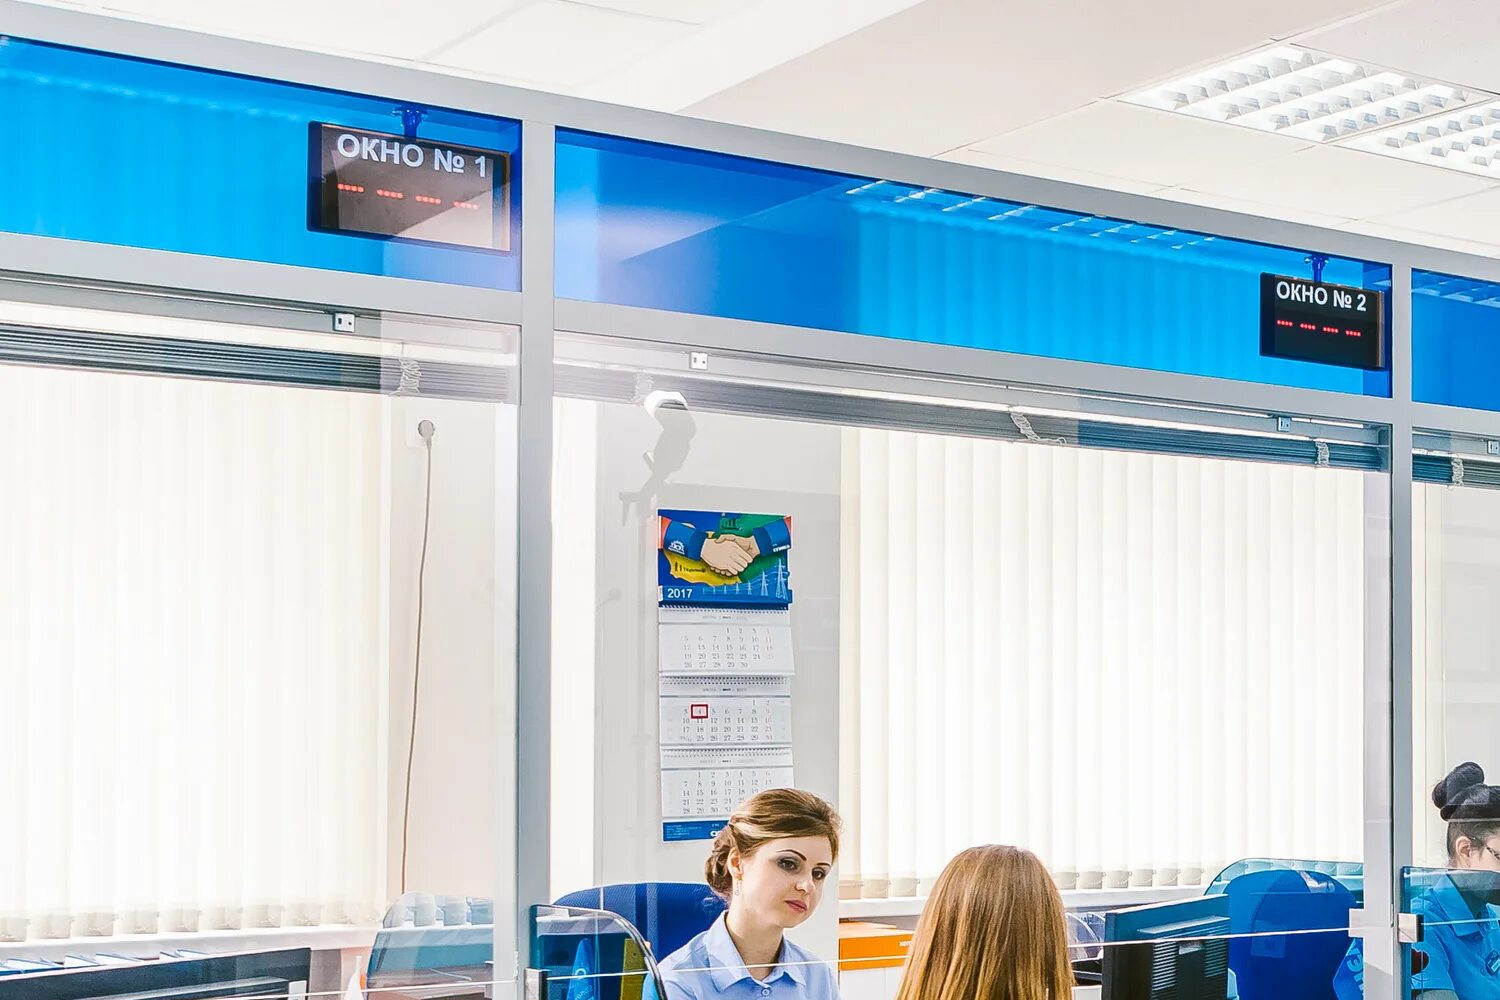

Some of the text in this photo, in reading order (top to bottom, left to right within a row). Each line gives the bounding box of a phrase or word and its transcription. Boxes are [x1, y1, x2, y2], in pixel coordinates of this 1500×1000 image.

[337, 133, 486, 178] ОКНО № 1
[1276, 281, 1367, 312] ОКНО № 2
[667, 588, 693, 599] 2017
